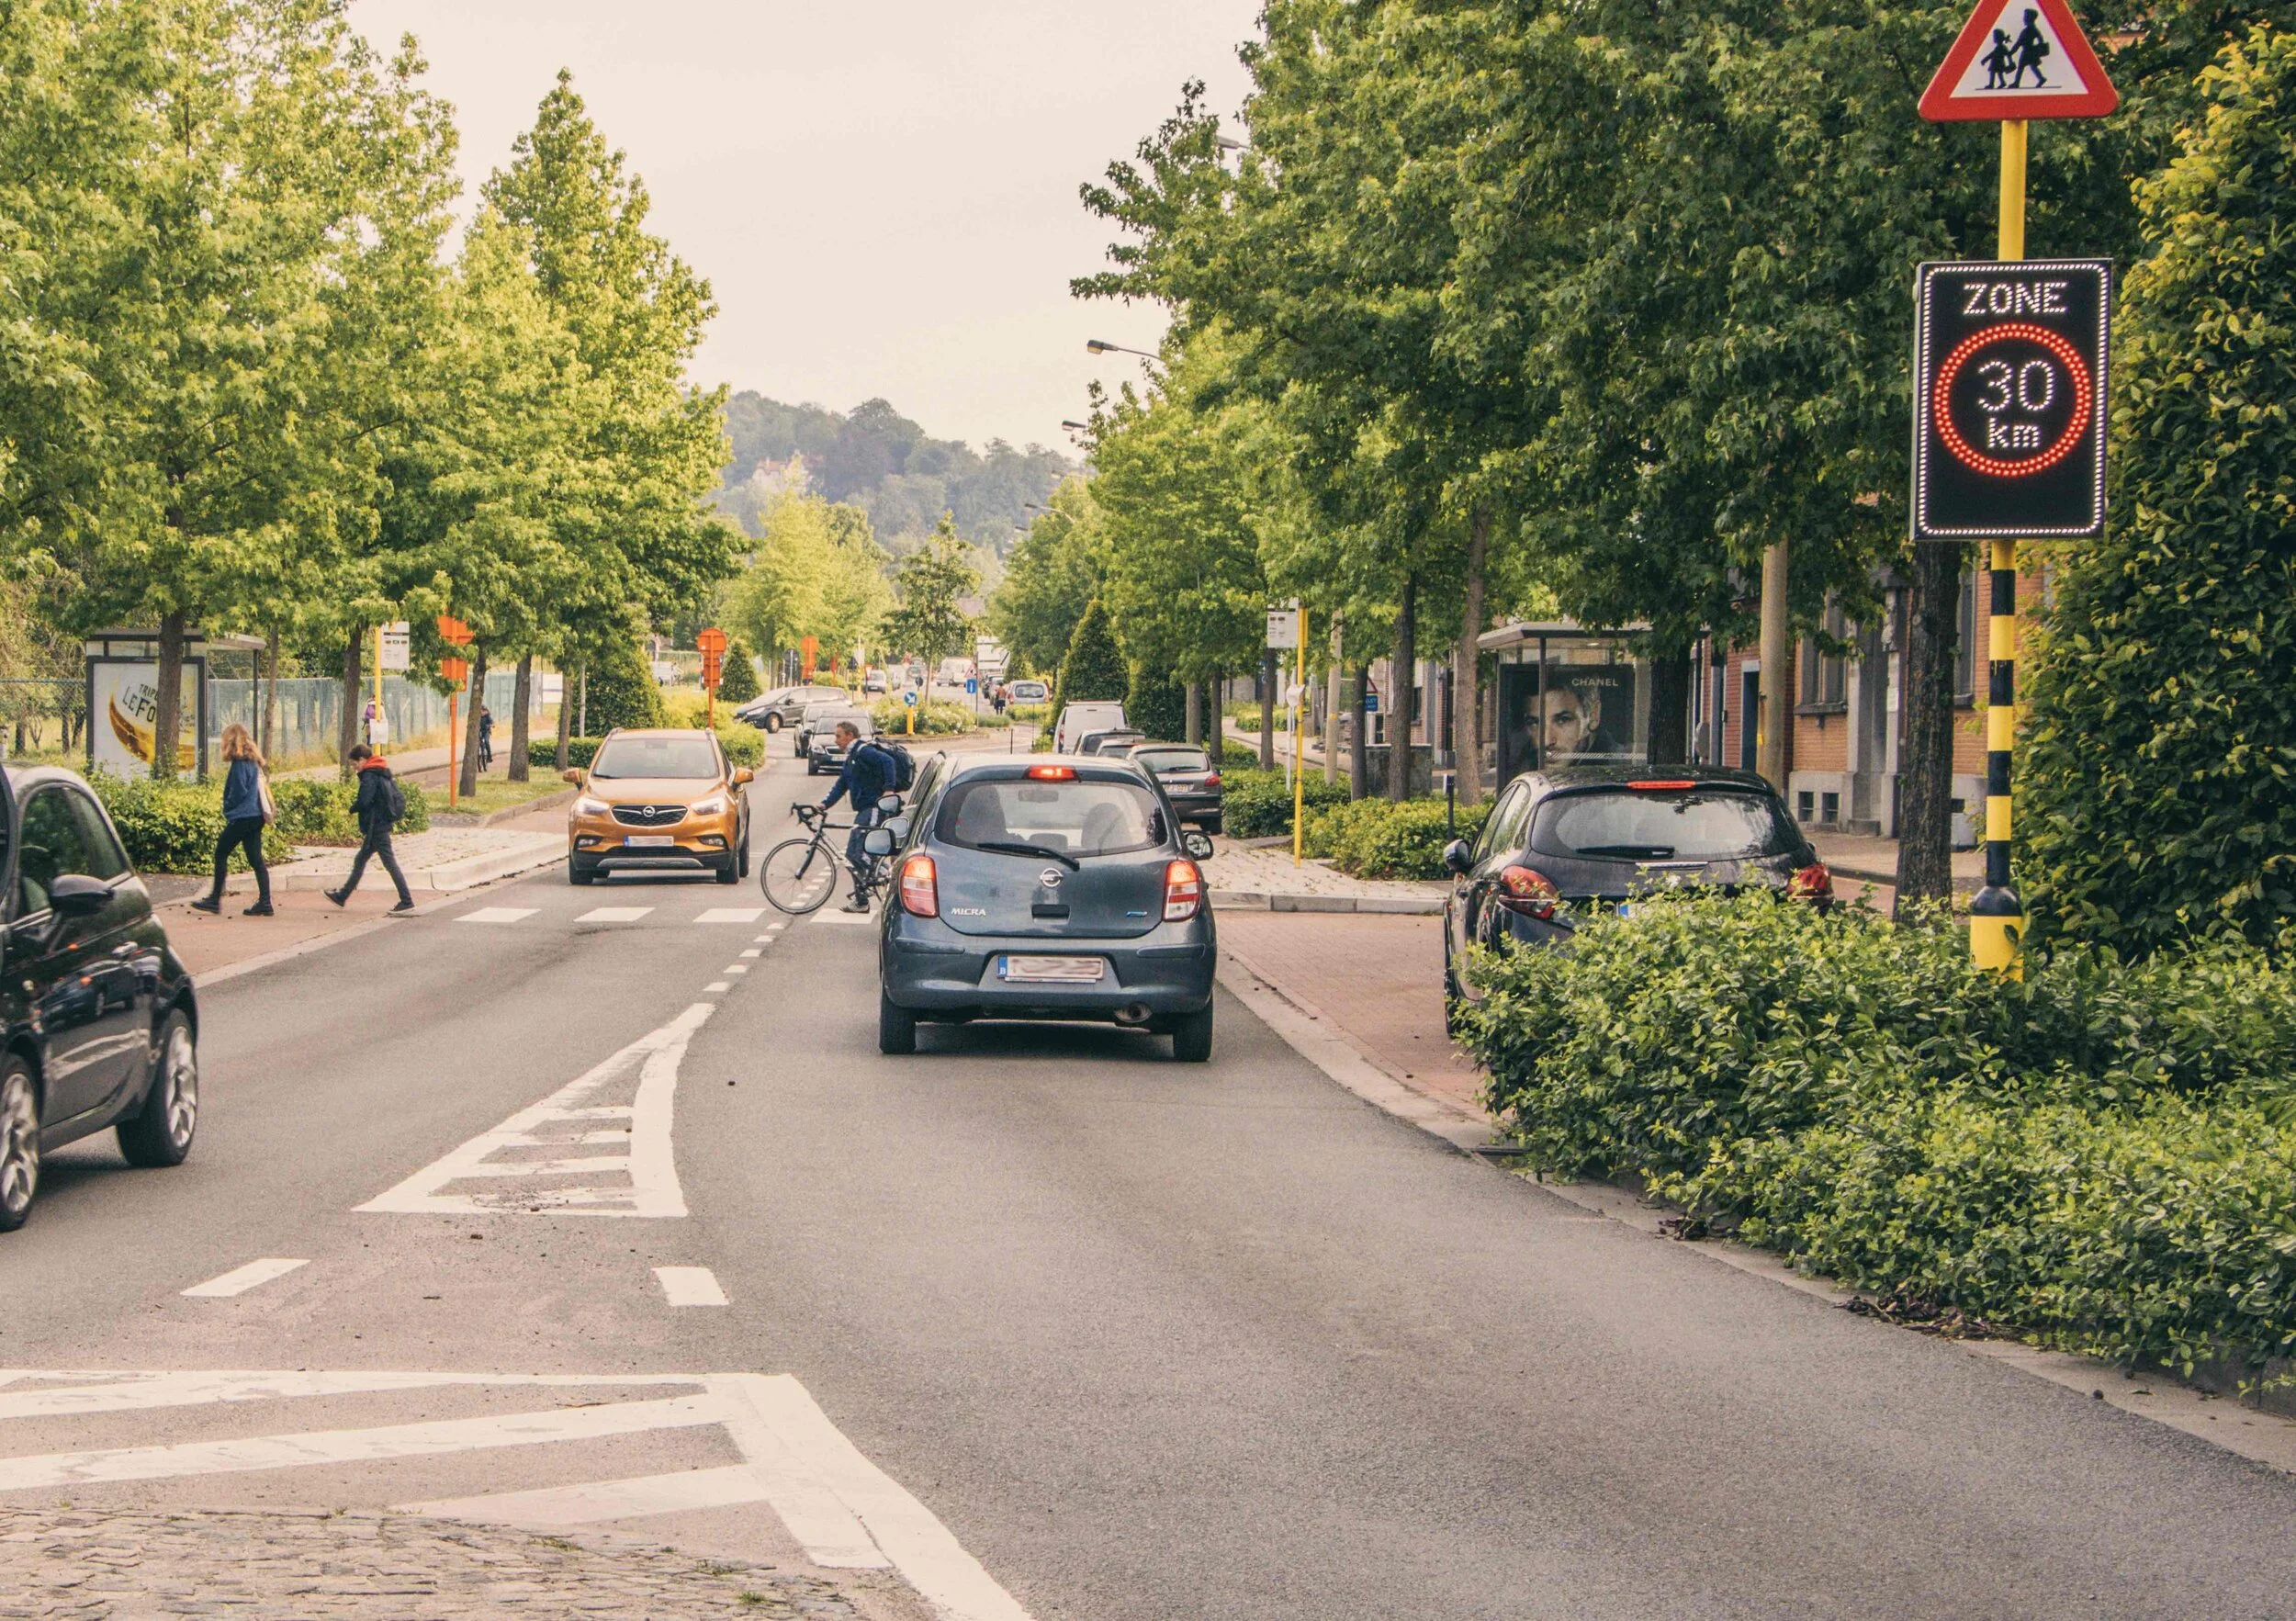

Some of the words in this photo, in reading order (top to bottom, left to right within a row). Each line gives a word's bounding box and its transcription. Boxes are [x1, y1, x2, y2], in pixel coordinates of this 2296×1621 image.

[1963, 282, 2068, 315] ZONE
[1978, 359, 2054, 411] 30
[1986, 417, 2042, 449] km
[1571, 678, 1619, 687] CHANEL
[951, 907, 987, 917] MICRA
